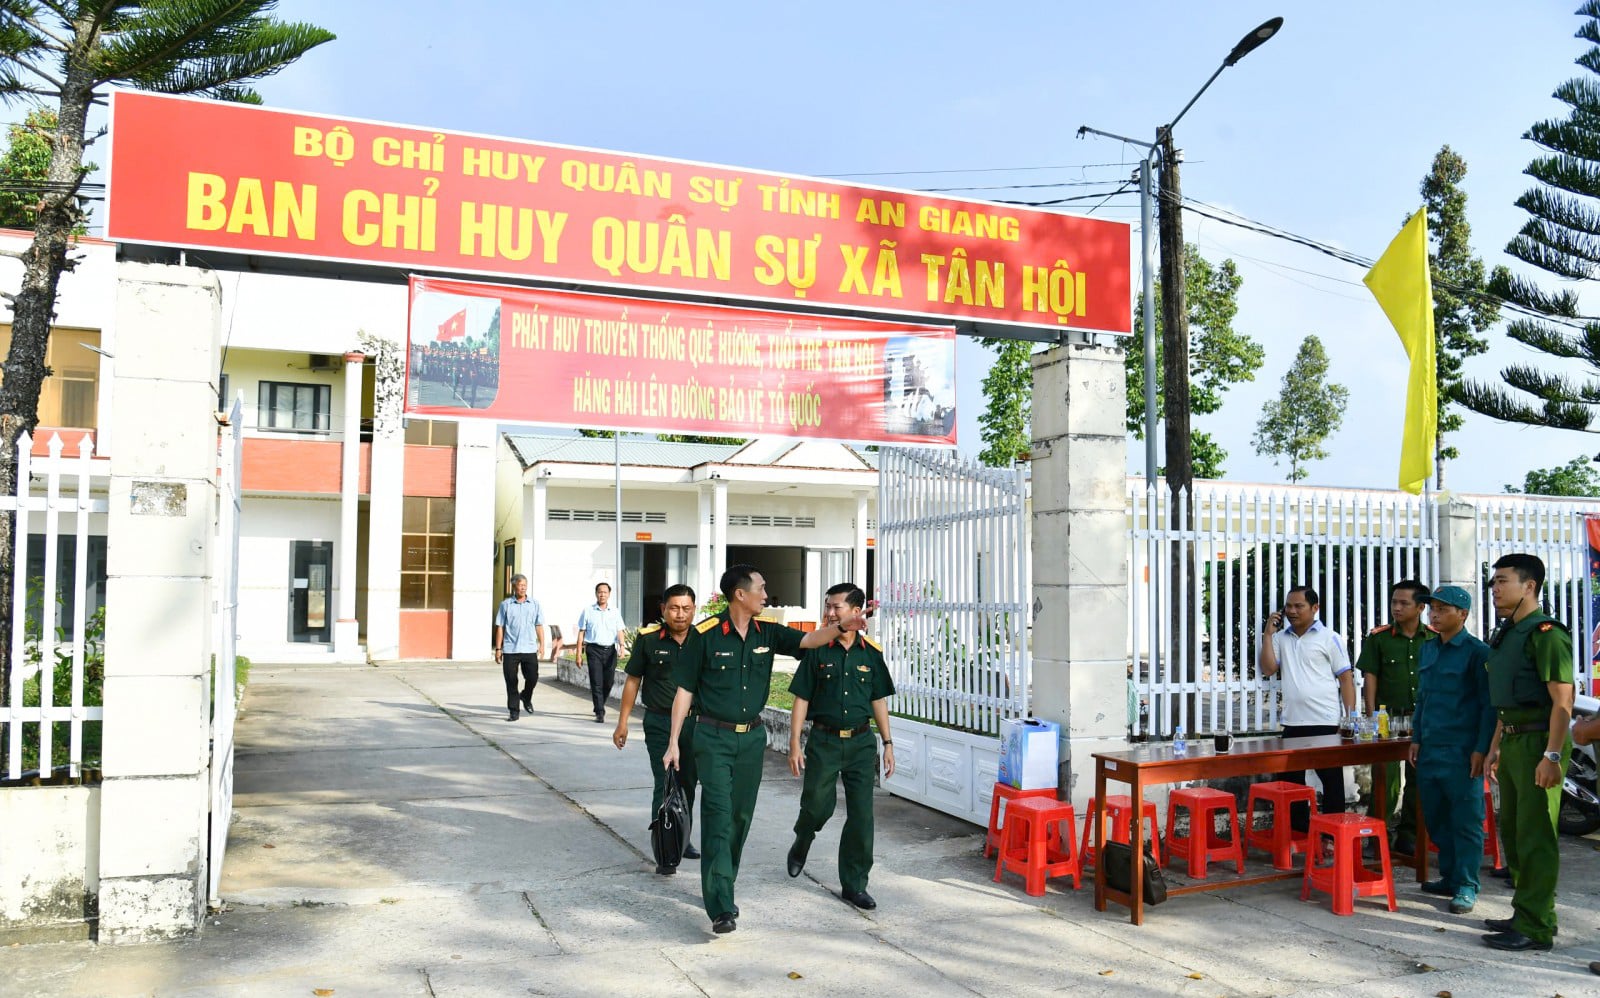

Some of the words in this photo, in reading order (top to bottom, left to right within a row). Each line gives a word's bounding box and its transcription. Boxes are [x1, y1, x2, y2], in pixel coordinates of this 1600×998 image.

[293, 126, 354, 167] BỘ
[372, 132, 446, 172] CHỈ
[462, 147, 546, 183] HUY
[561, 159, 672, 199] QUÂN
[688, 176, 742, 212] SỰ
[758, 180, 840, 219] TỈNH
[856, 198, 906, 227] AN
[918, 206, 1020, 241] GIANG
[186, 171, 317, 241] BAN
[342, 177, 438, 252] CHỈ
[459, 201, 568, 264] HUY
[591, 213, 732, 281] QUÂN
[753, 234, 822, 298] SỰ
[839, 240, 903, 297] XÃ
[921, 247, 1005, 309] TÂN
[1022, 258, 1087, 324] HỘI
[511, 304, 549, 350] PHÁT
[552, 316, 581, 353] HUY
[584, 307, 638, 358] TRUYỀN
[641, 312, 686, 362] THỐNG
[688, 321, 714, 368] QUÊ
[718, 326, 764, 374] HƯƠNG,
[767, 319, 796, 369] TUỔI
[573, 371, 611, 415] HĂNG
[614, 372, 637, 416] HÁI
[641, 373, 669, 418] LÊN
[671, 375, 716, 421] ĐƯỜNG
[718, 374, 745, 423] BẢO
[748, 381, 765, 430] VỆ
[768, 374, 786, 425] TỔ
[789, 382, 822, 432] QUỐC
